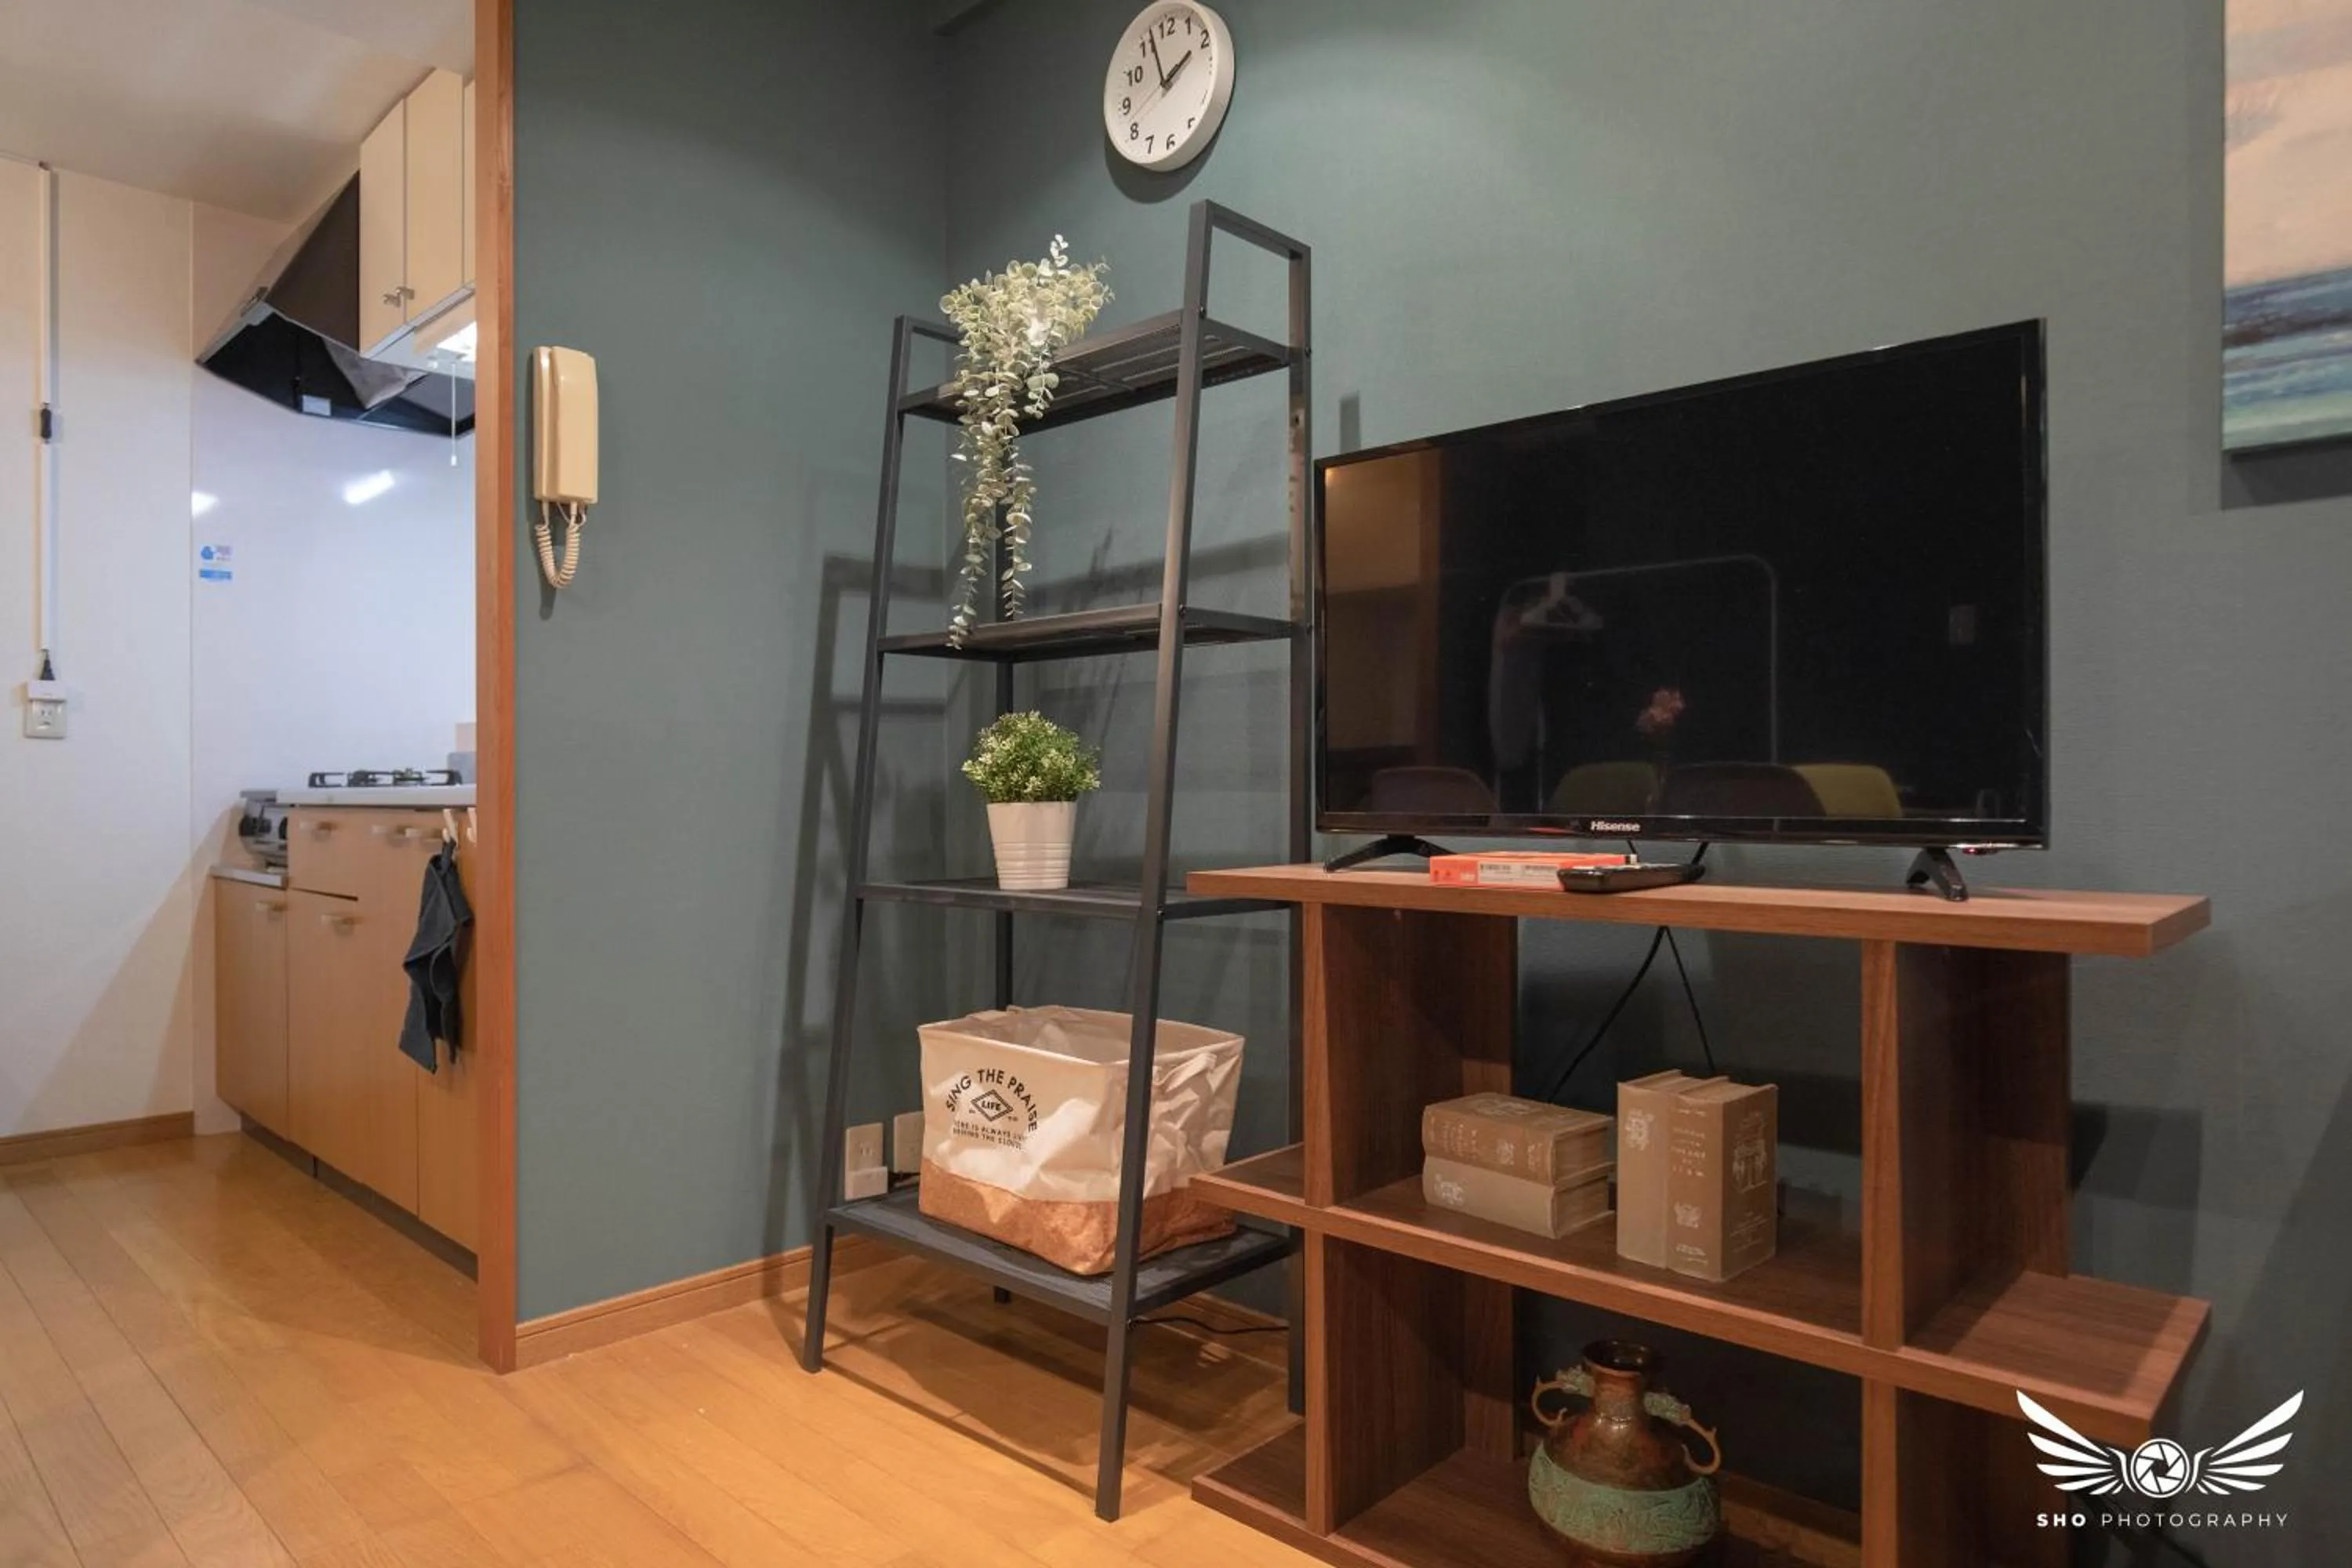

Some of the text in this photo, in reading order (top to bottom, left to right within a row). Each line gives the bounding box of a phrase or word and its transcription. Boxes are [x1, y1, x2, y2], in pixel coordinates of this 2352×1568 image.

[1159, 17, 1176, 38] 12
[1185, 16, 1192, 35] 1
[1200, 29, 1210, 49] 2
[1126, 65, 1143, 86] 10
[1122, 97, 1131, 115] 9
[1130, 122, 1139, 140] 8
[1145, 135, 1155, 154] 7
[1591, 820, 1640, 833] Hisense
[945, 1068, 1037, 1132] SING THE PRAISE
[981, 1101, 1002, 1111] LIFE
